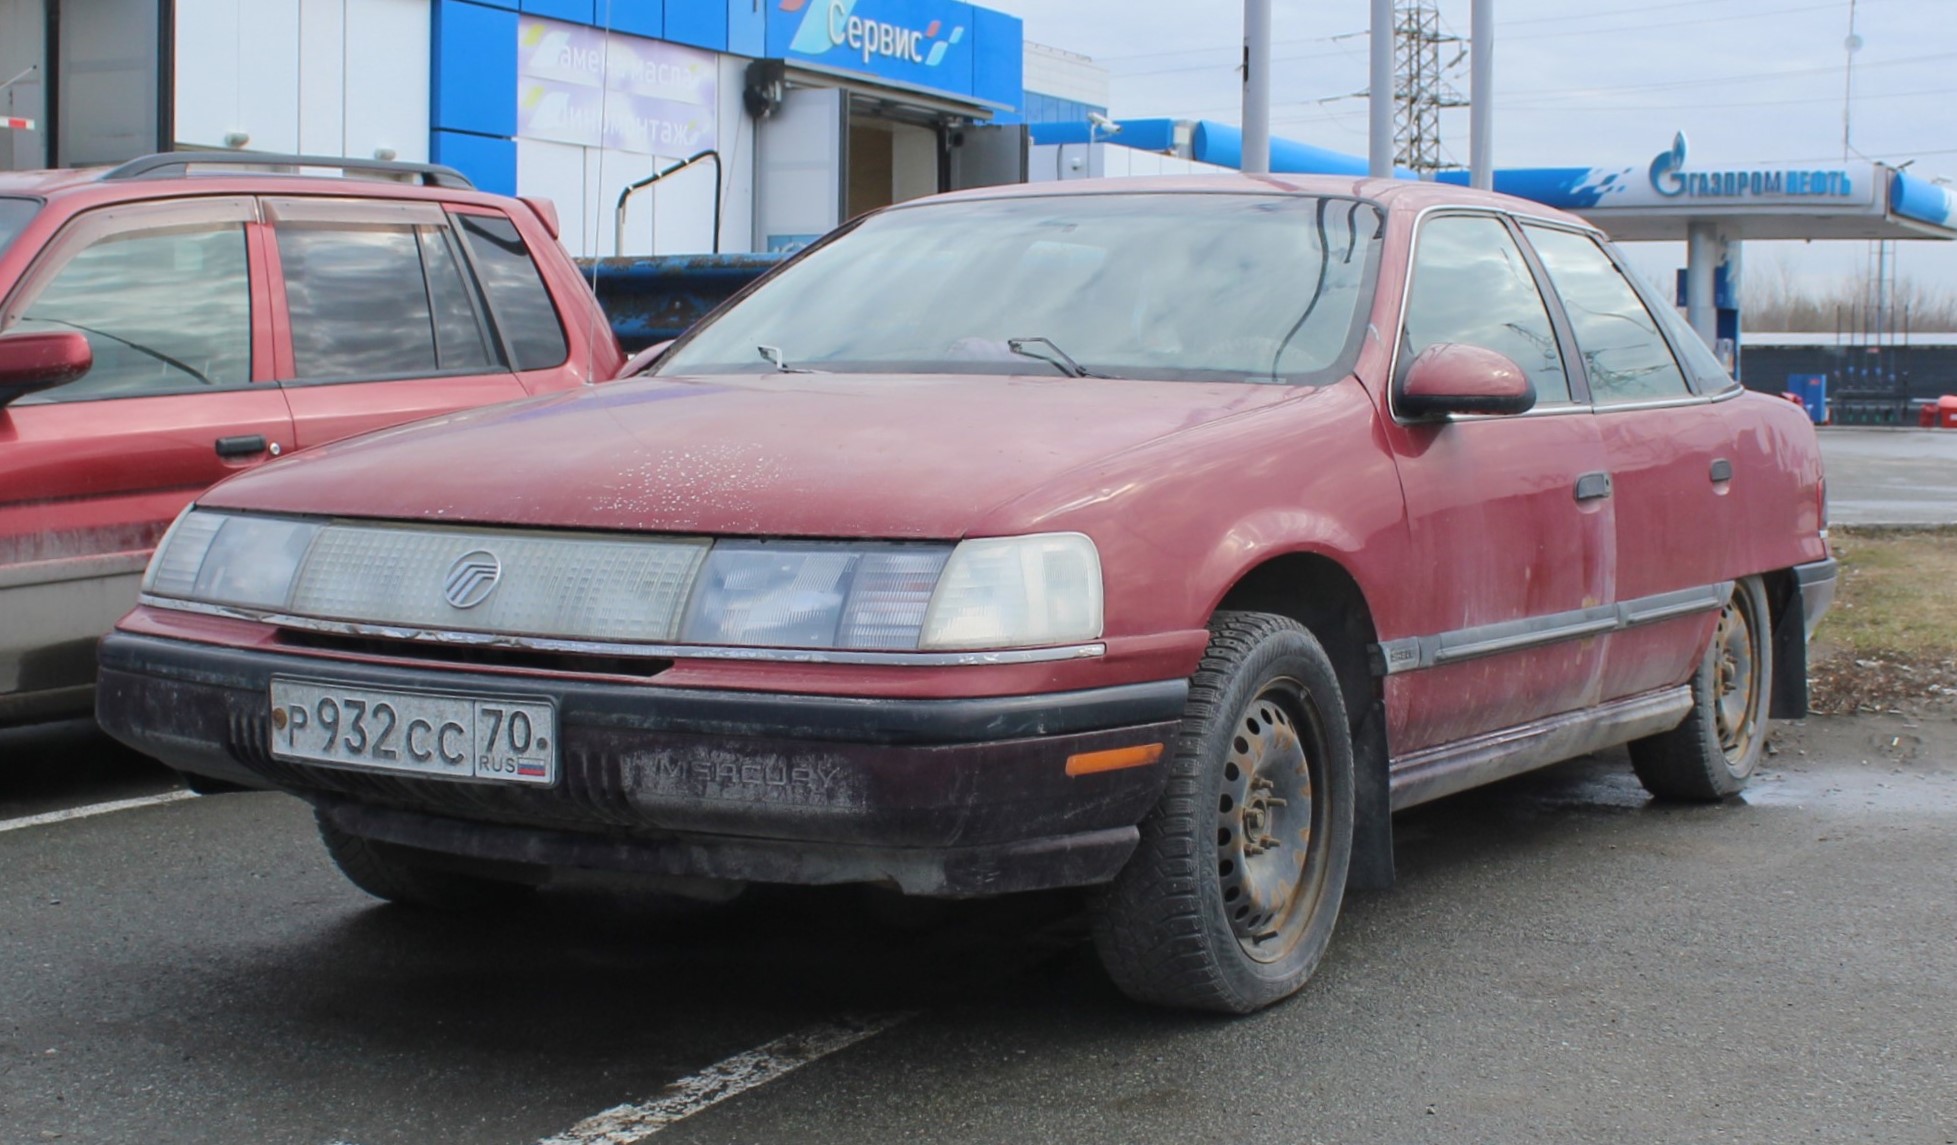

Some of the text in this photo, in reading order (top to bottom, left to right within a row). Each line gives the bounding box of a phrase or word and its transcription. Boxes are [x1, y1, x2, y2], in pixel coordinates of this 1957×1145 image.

[828, 0, 923, 64] Сервис
[1688, 170, 1852, 197] ГАЗПРОМ НЕФТЬ
[480, 707, 532, 755] 70
[478, 755, 516, 774] RUS
